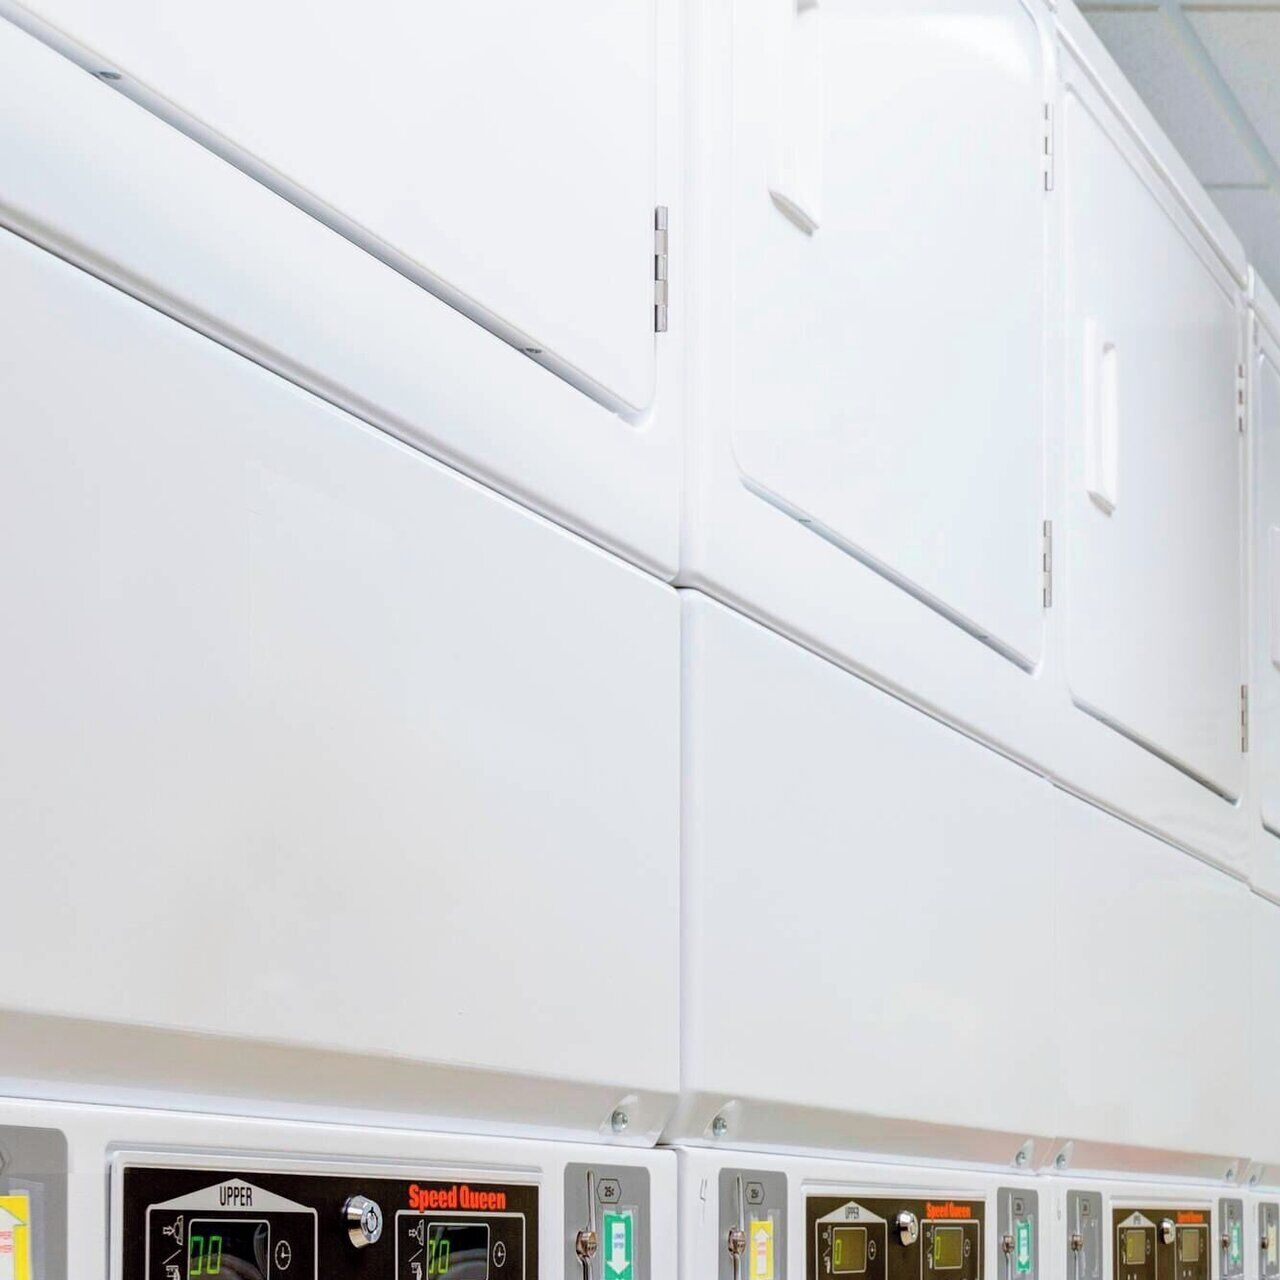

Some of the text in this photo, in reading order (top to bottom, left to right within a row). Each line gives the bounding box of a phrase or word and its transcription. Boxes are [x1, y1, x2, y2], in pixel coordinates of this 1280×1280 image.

[219, 1186, 253, 1206] UPPER
[409, 1184, 506, 1213] Speed Queen
